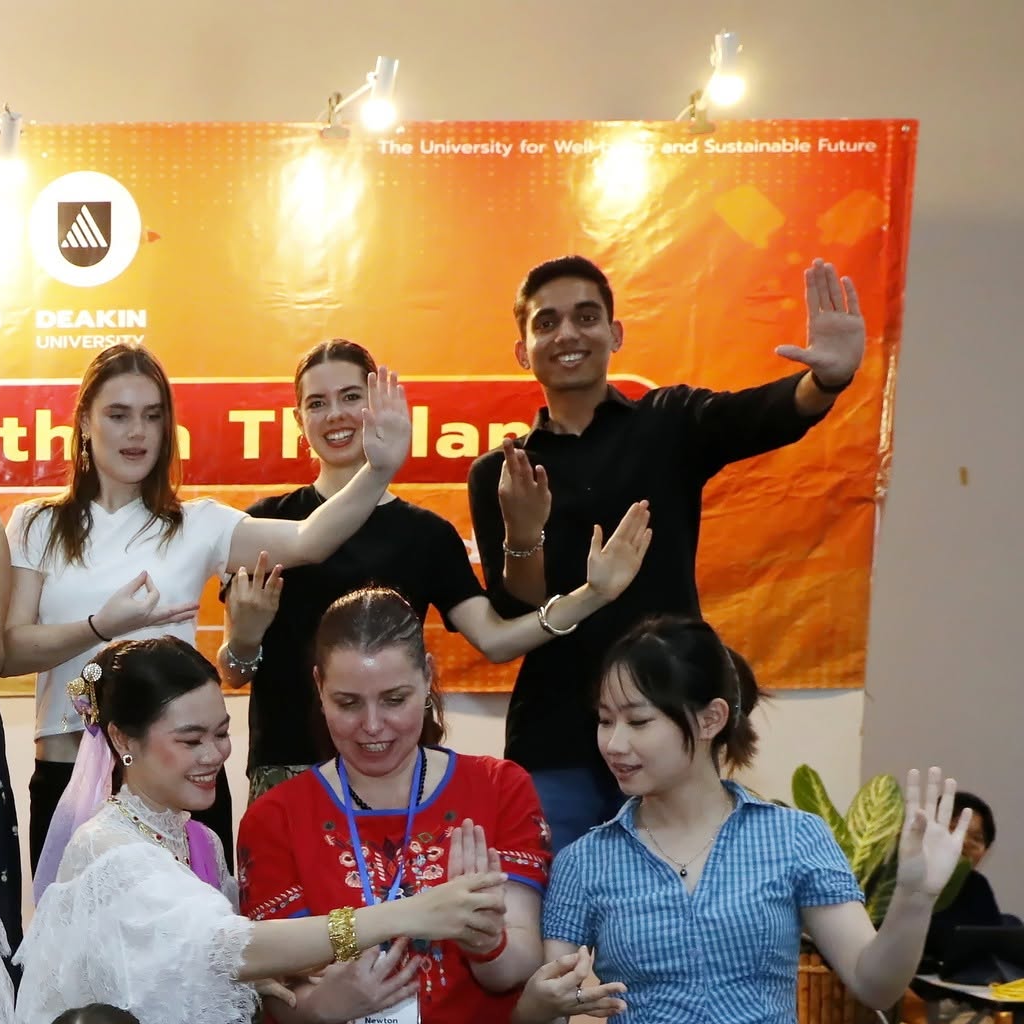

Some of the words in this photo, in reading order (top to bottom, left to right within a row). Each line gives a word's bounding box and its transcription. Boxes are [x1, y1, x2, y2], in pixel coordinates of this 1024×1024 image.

[379, 140, 413, 154] The
[420, 140, 513, 157] University
[520, 139, 546, 154] for
[661, 140, 698, 154] and
[704, 138, 811, 153] Sustainable
[818, 138, 877, 152] Future
[35, 310, 146, 328] DEAKIN
